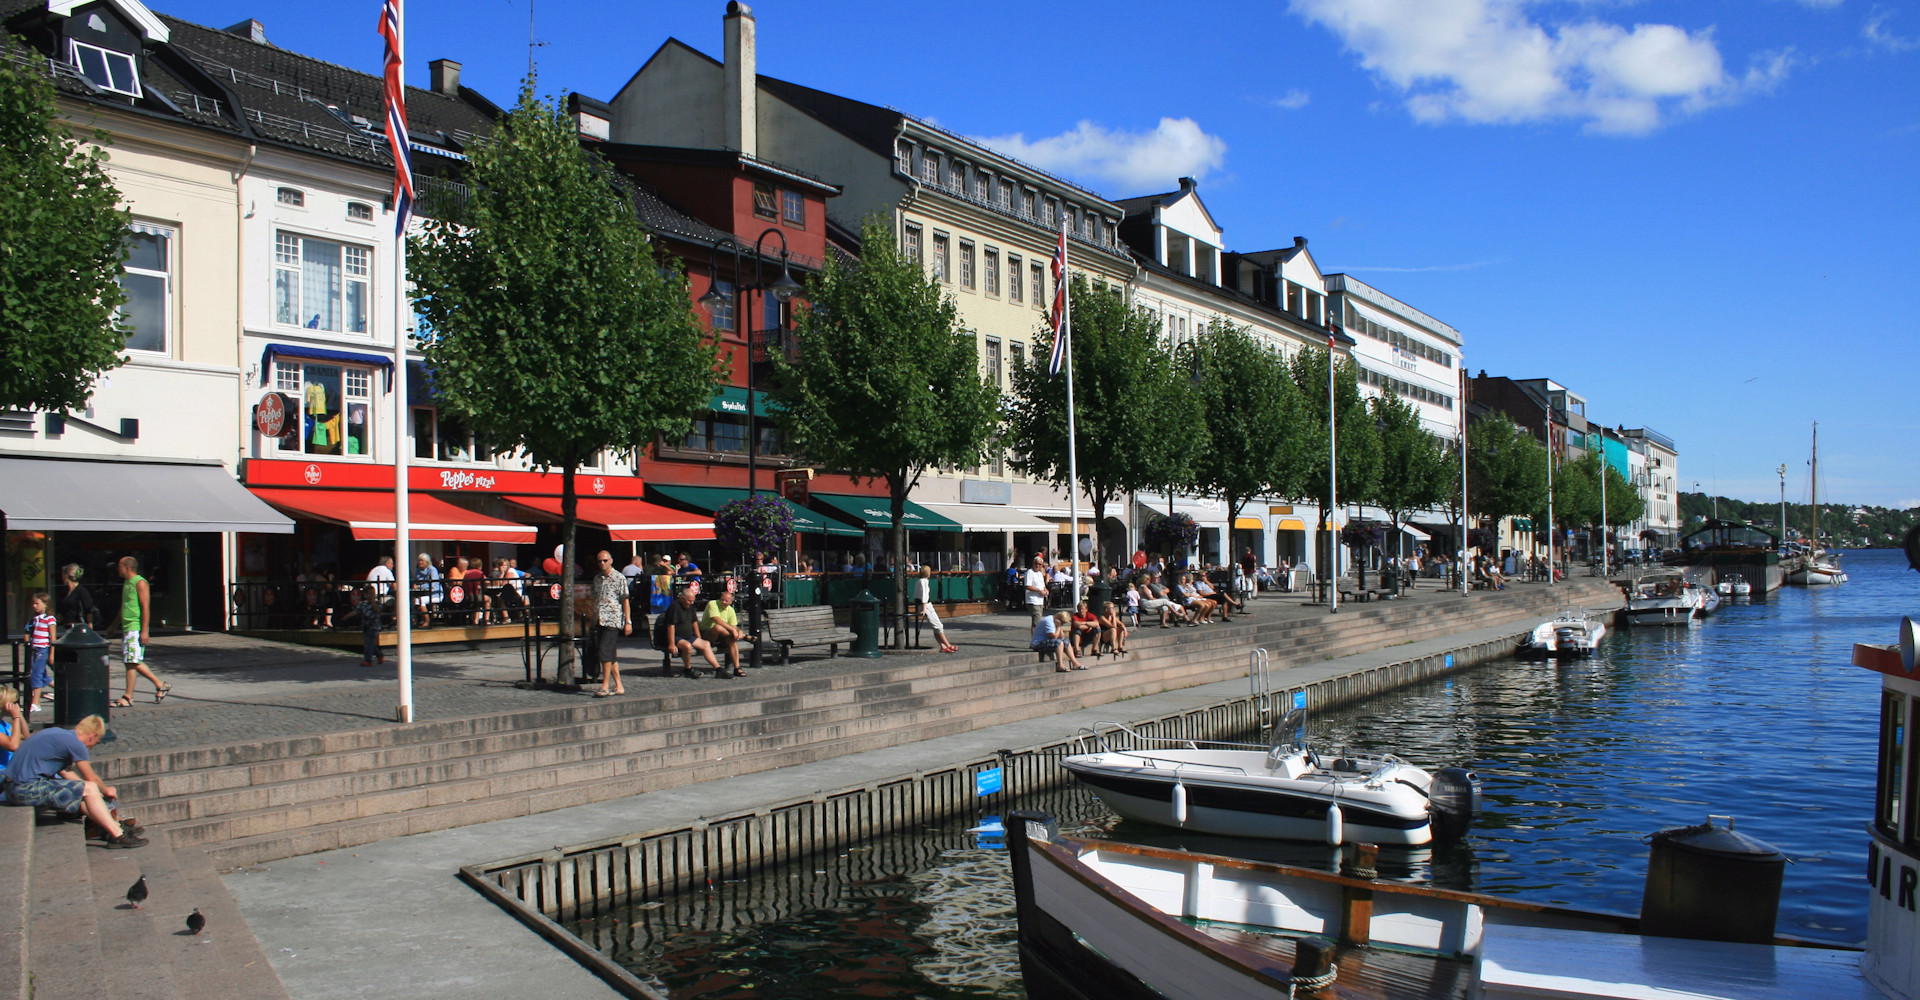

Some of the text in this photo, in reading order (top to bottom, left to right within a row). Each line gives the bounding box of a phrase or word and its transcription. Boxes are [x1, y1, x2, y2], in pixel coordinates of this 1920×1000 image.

[260, 408, 282, 424] Peppes
[440, 470, 496, 490] Peppes PIZZA
